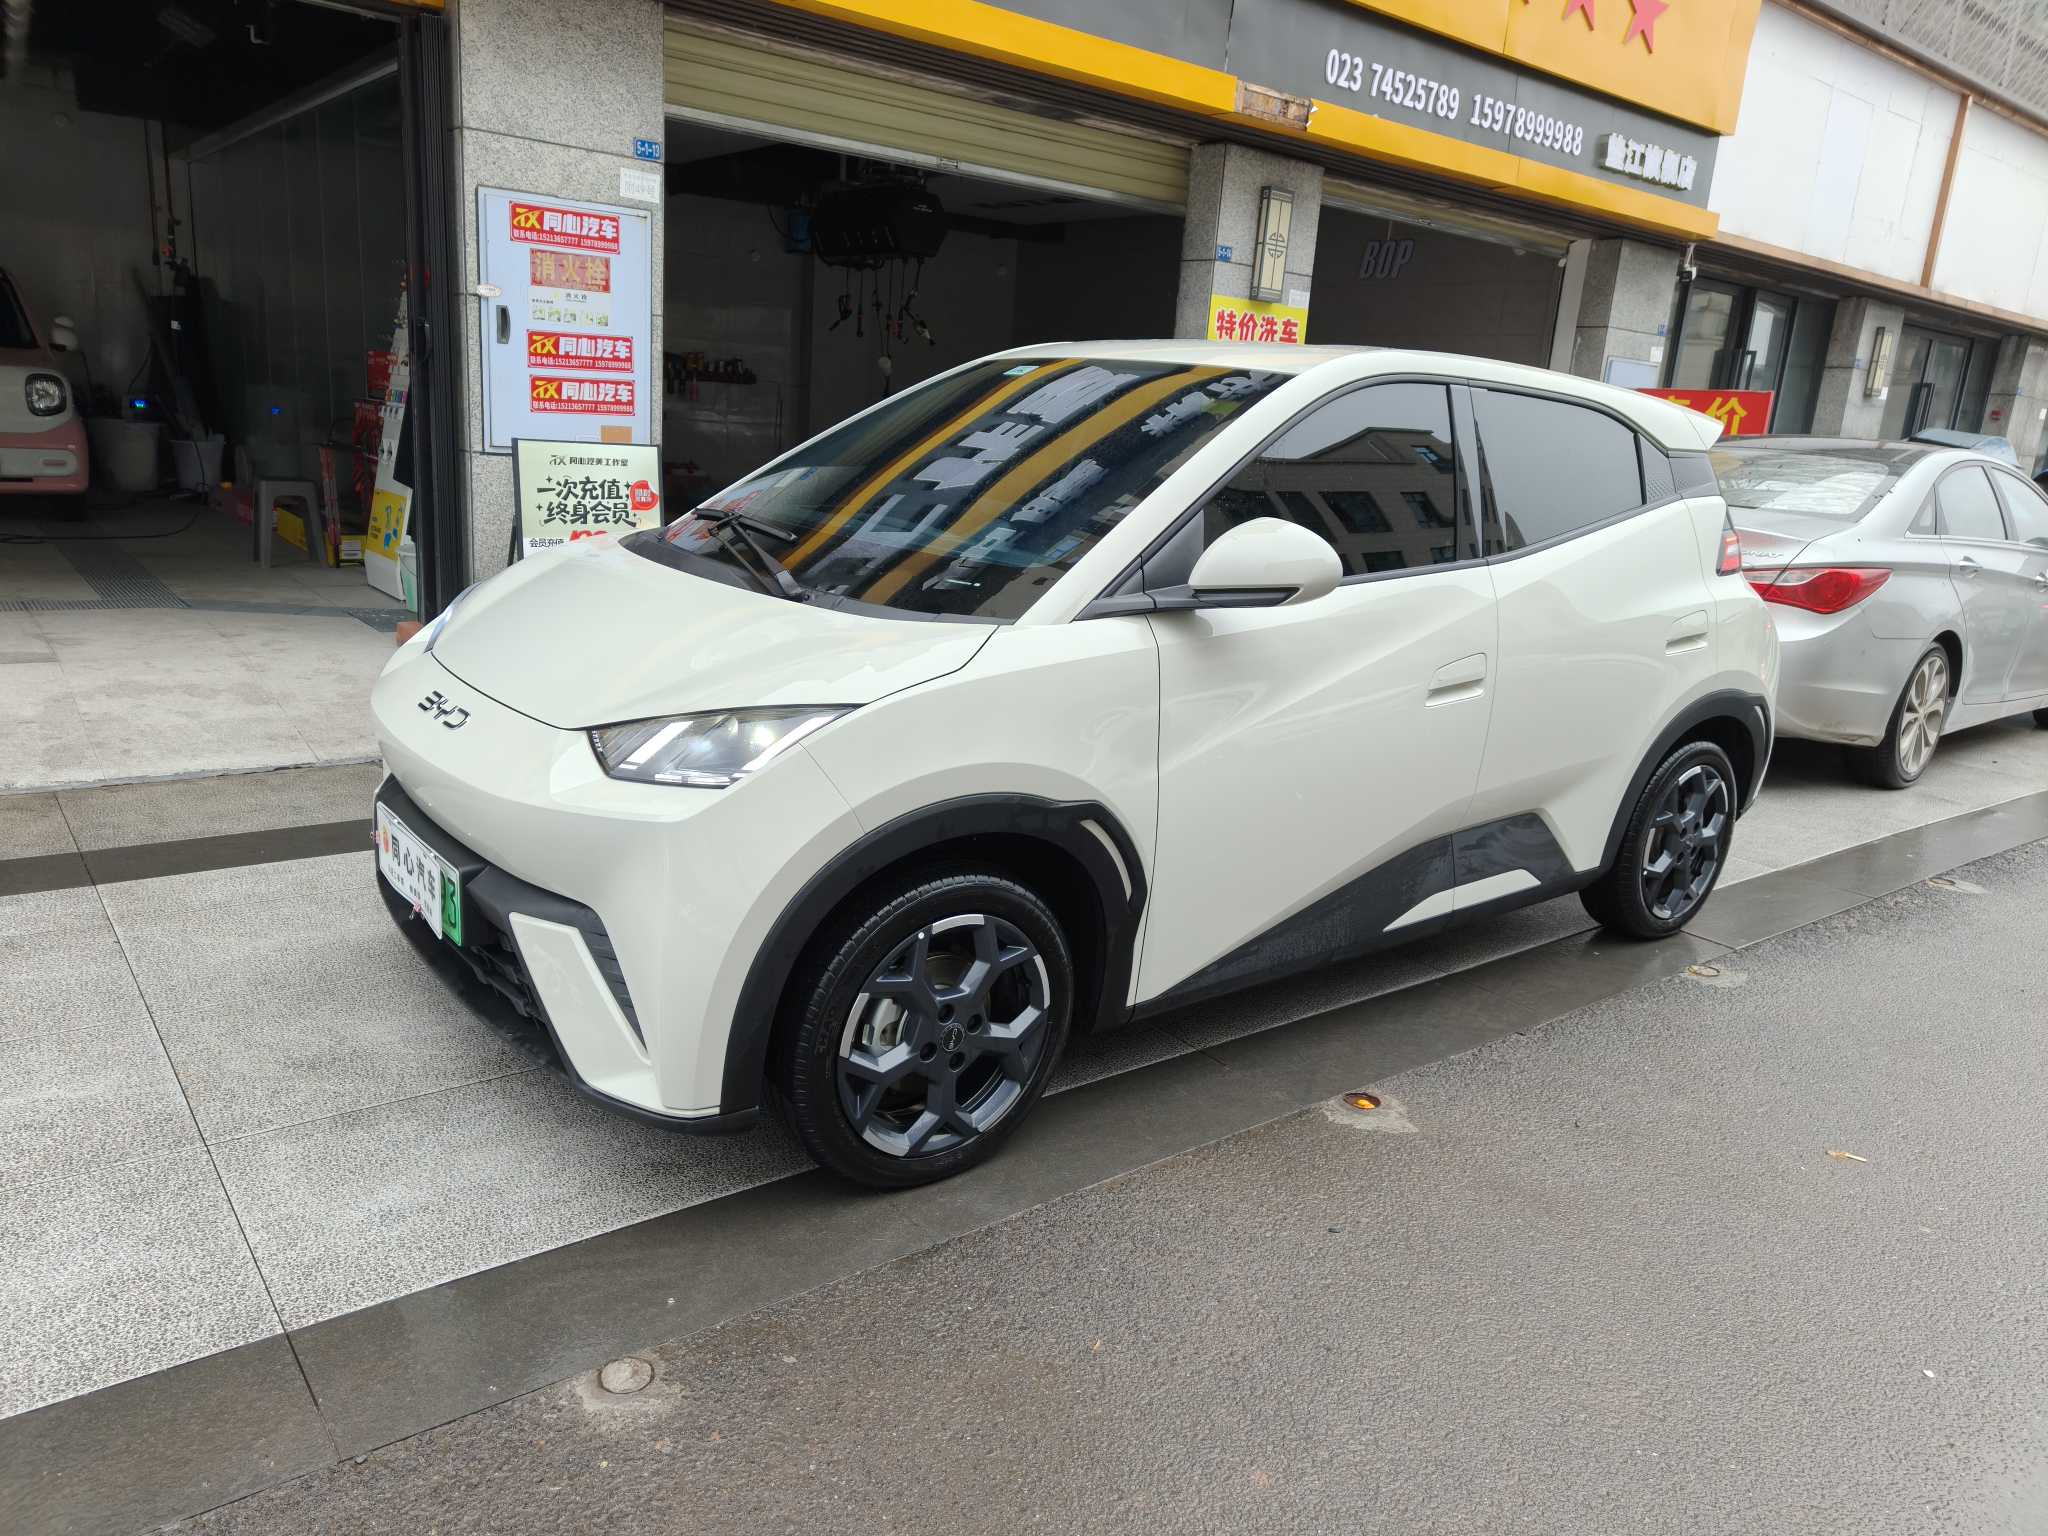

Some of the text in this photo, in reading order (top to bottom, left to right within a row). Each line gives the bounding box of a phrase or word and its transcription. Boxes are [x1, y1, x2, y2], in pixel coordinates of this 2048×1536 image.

[1325, 48, 1583, 156] 023 74525789 15978999988
[636, 140, 660, 158] 5-1-13
[543, 211, 618, 239] 同心汽车
[534, 252, 607, 285] 消火栓
[1215, 309, 1299, 343] 特价洗车
[559, 336, 631, 359] 同心汽车
[561, 381, 633, 403] 同心汽车
[537, 477, 623, 500] 一次充值
[544, 500, 637, 527] 终身会员
[417, 690, 471, 729] BYD
[391, 834, 437, 901] 同心汽车
